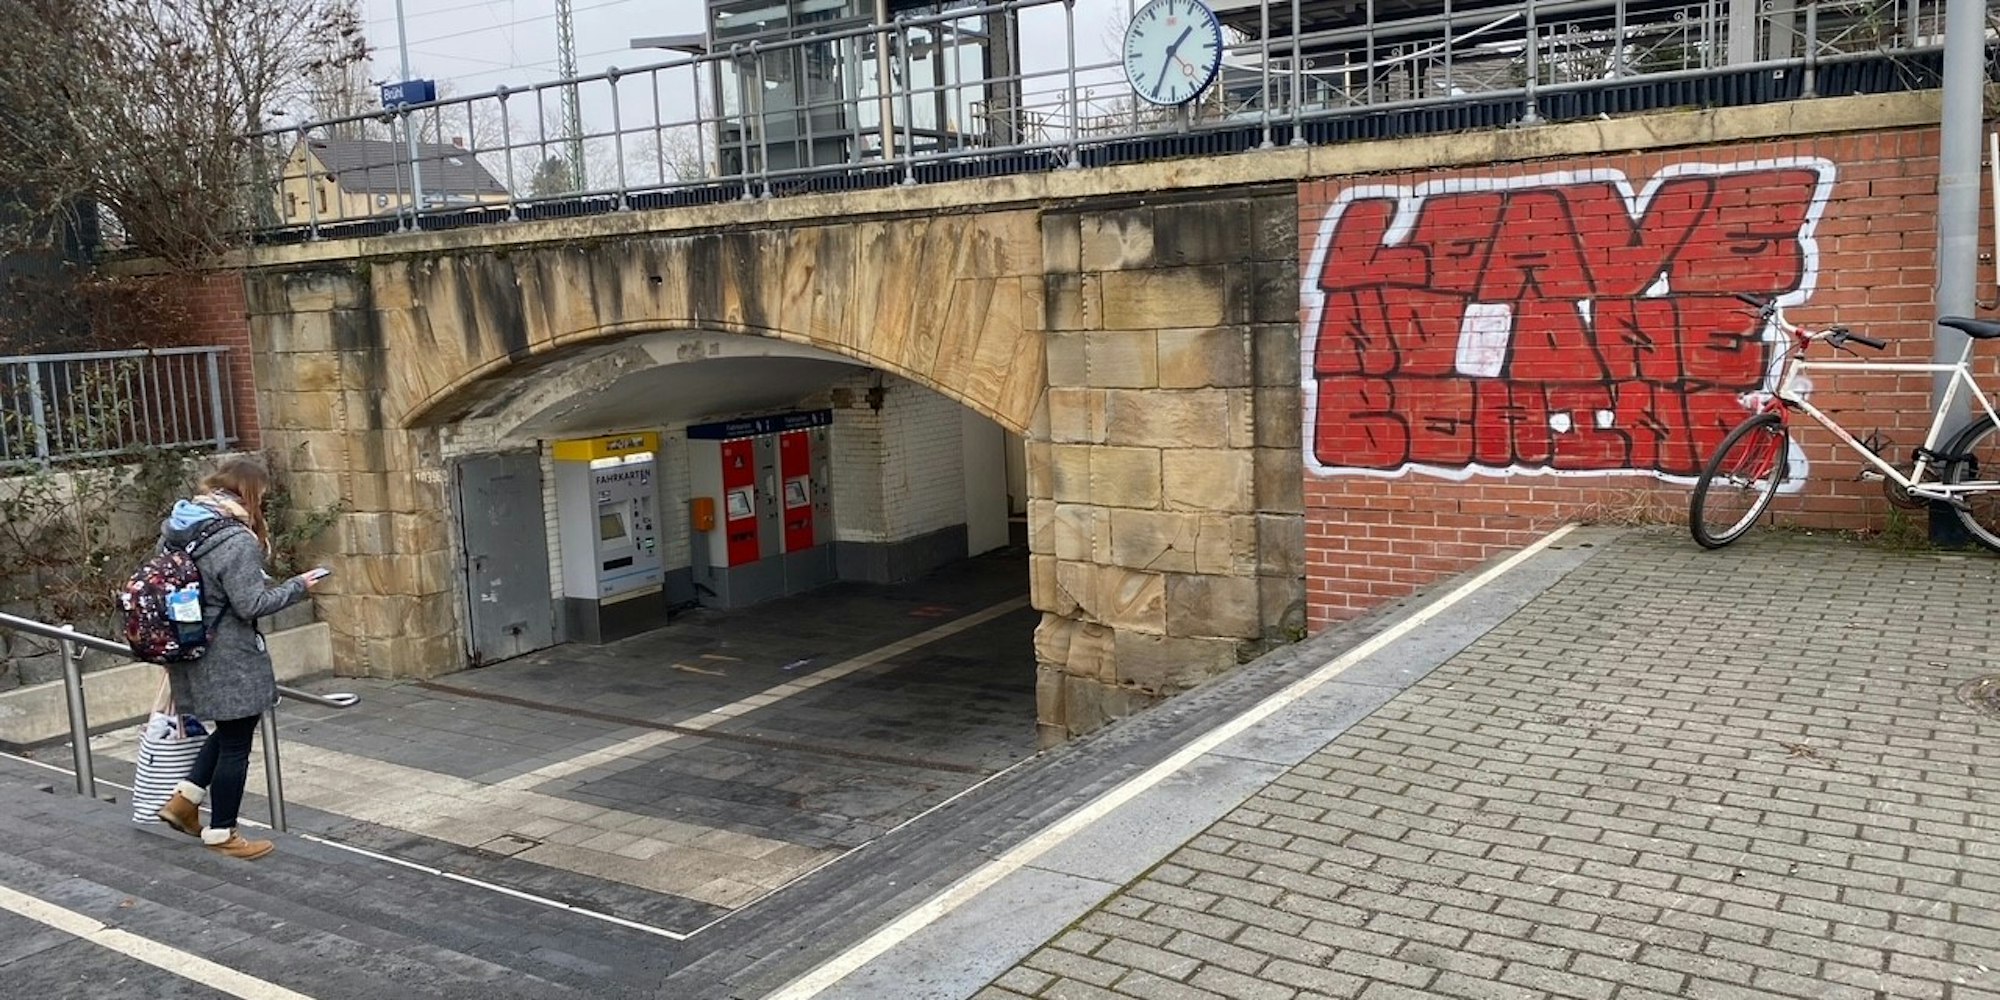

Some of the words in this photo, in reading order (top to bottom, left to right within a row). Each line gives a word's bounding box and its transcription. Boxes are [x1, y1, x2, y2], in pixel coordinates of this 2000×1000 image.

[1318, 169, 1820, 302] LEAVE
[1313, 287, 1469, 378] NO
[595, 468, 651, 485] FAHRKARTEN
